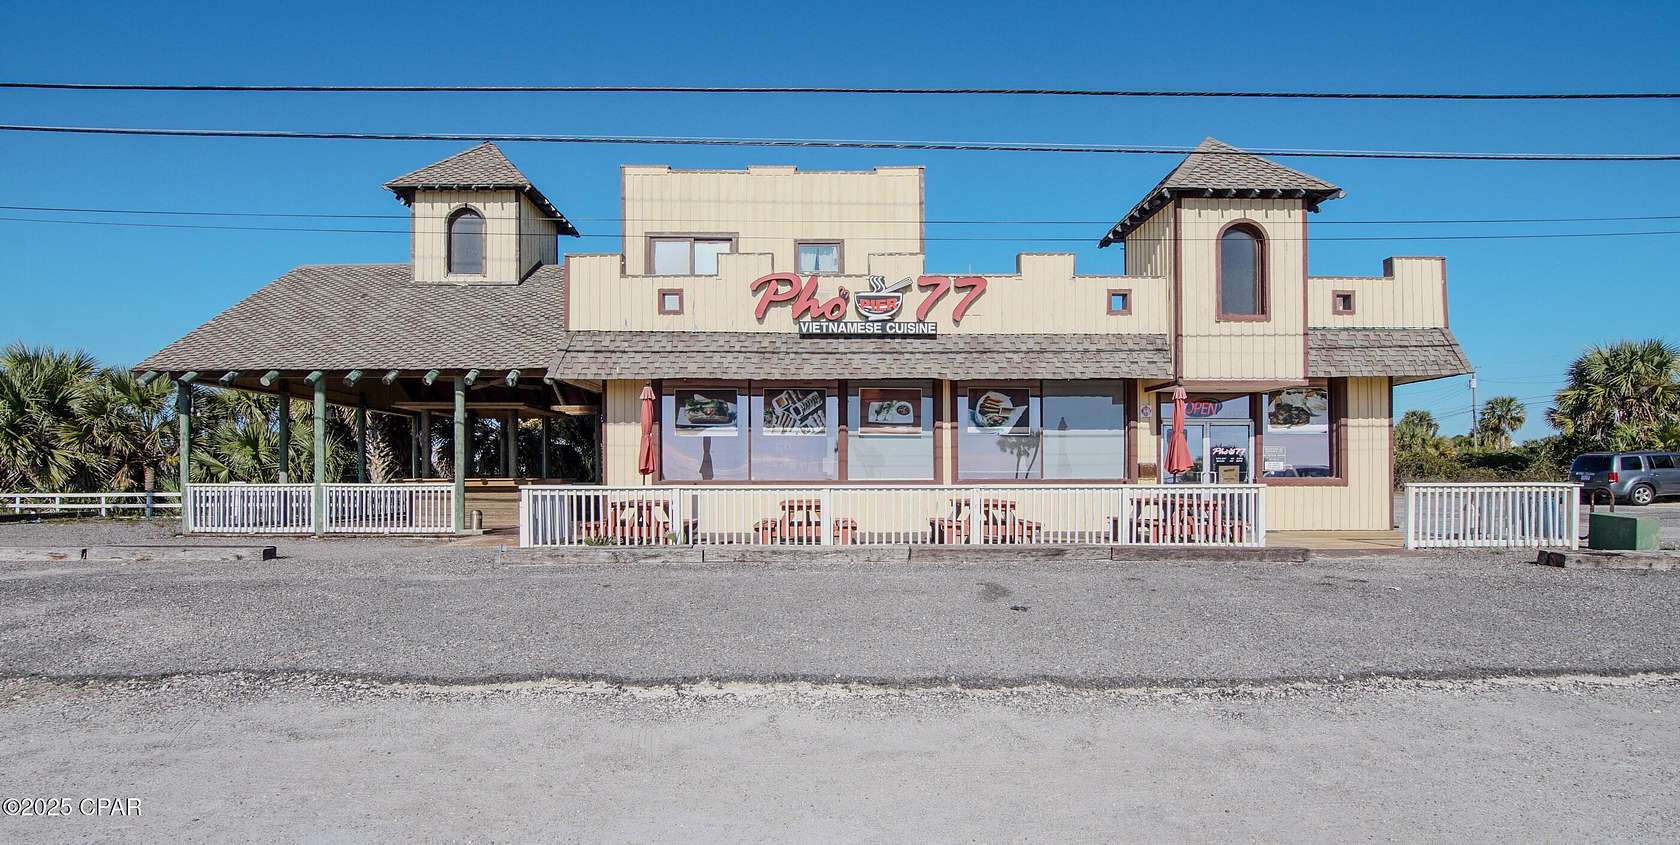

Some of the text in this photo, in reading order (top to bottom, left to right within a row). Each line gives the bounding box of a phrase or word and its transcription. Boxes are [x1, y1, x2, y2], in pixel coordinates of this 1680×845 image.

[859, 298, 897, 311] PIER
[916, 275, 987, 323] 77
[800, 322, 936, 333] VIETNAMESE CUISINE
[1184, 401, 1217, 414] OPEN
